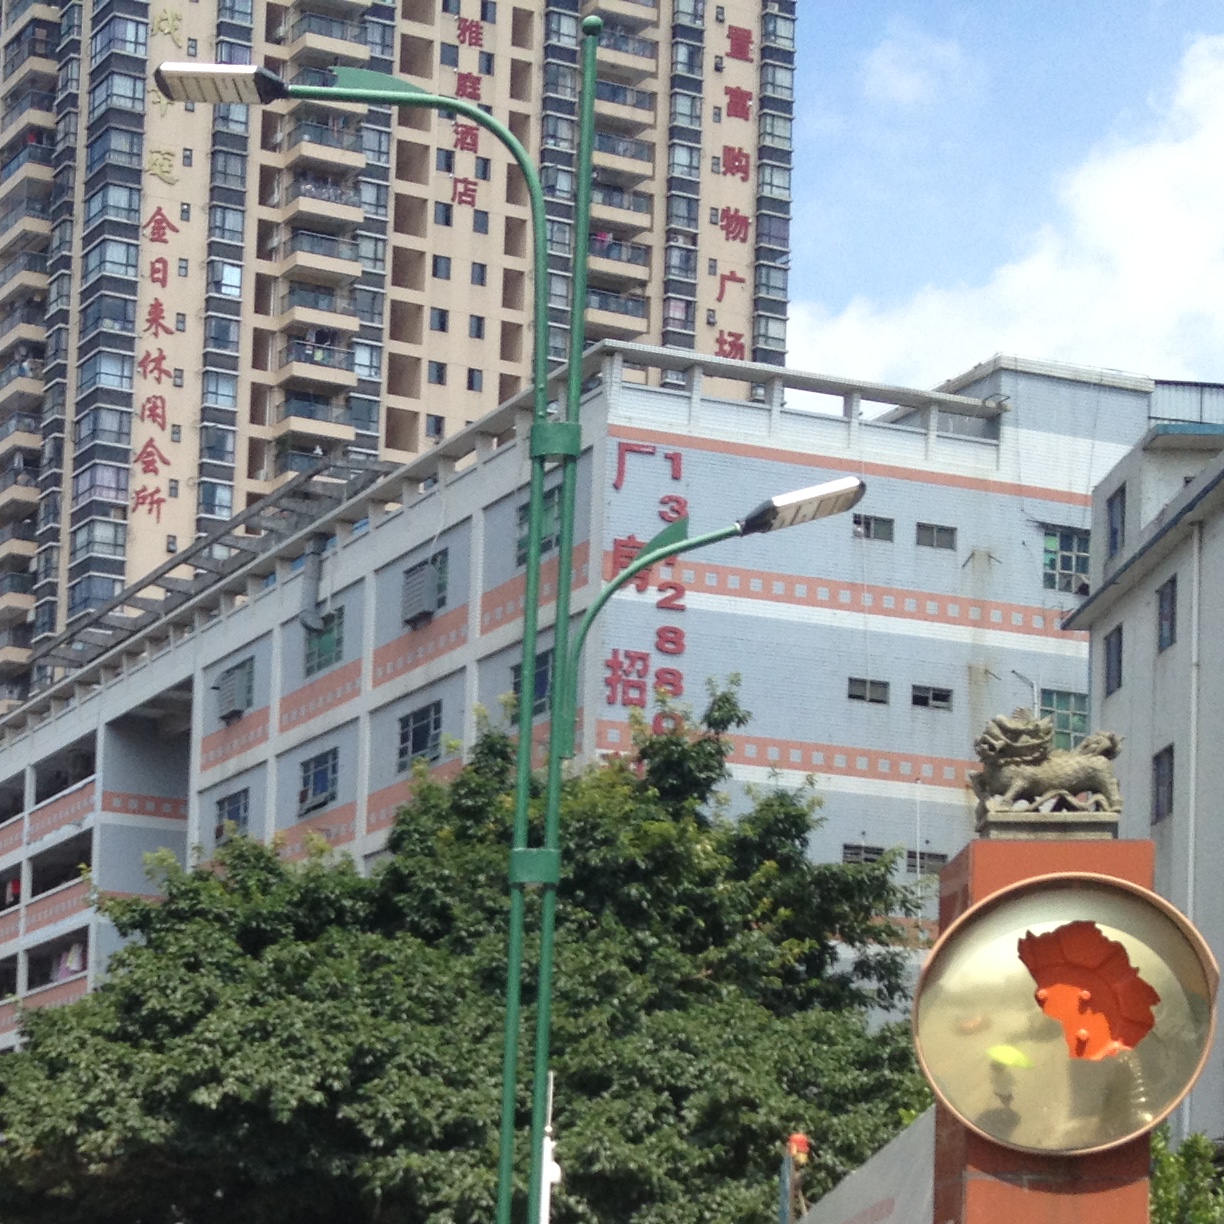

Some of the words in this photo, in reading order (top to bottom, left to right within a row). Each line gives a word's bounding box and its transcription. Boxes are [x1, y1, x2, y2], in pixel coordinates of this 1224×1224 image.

[132, 206, 179, 524] 金日来休闲会所
[602, 443, 656, 779] 厂房招
